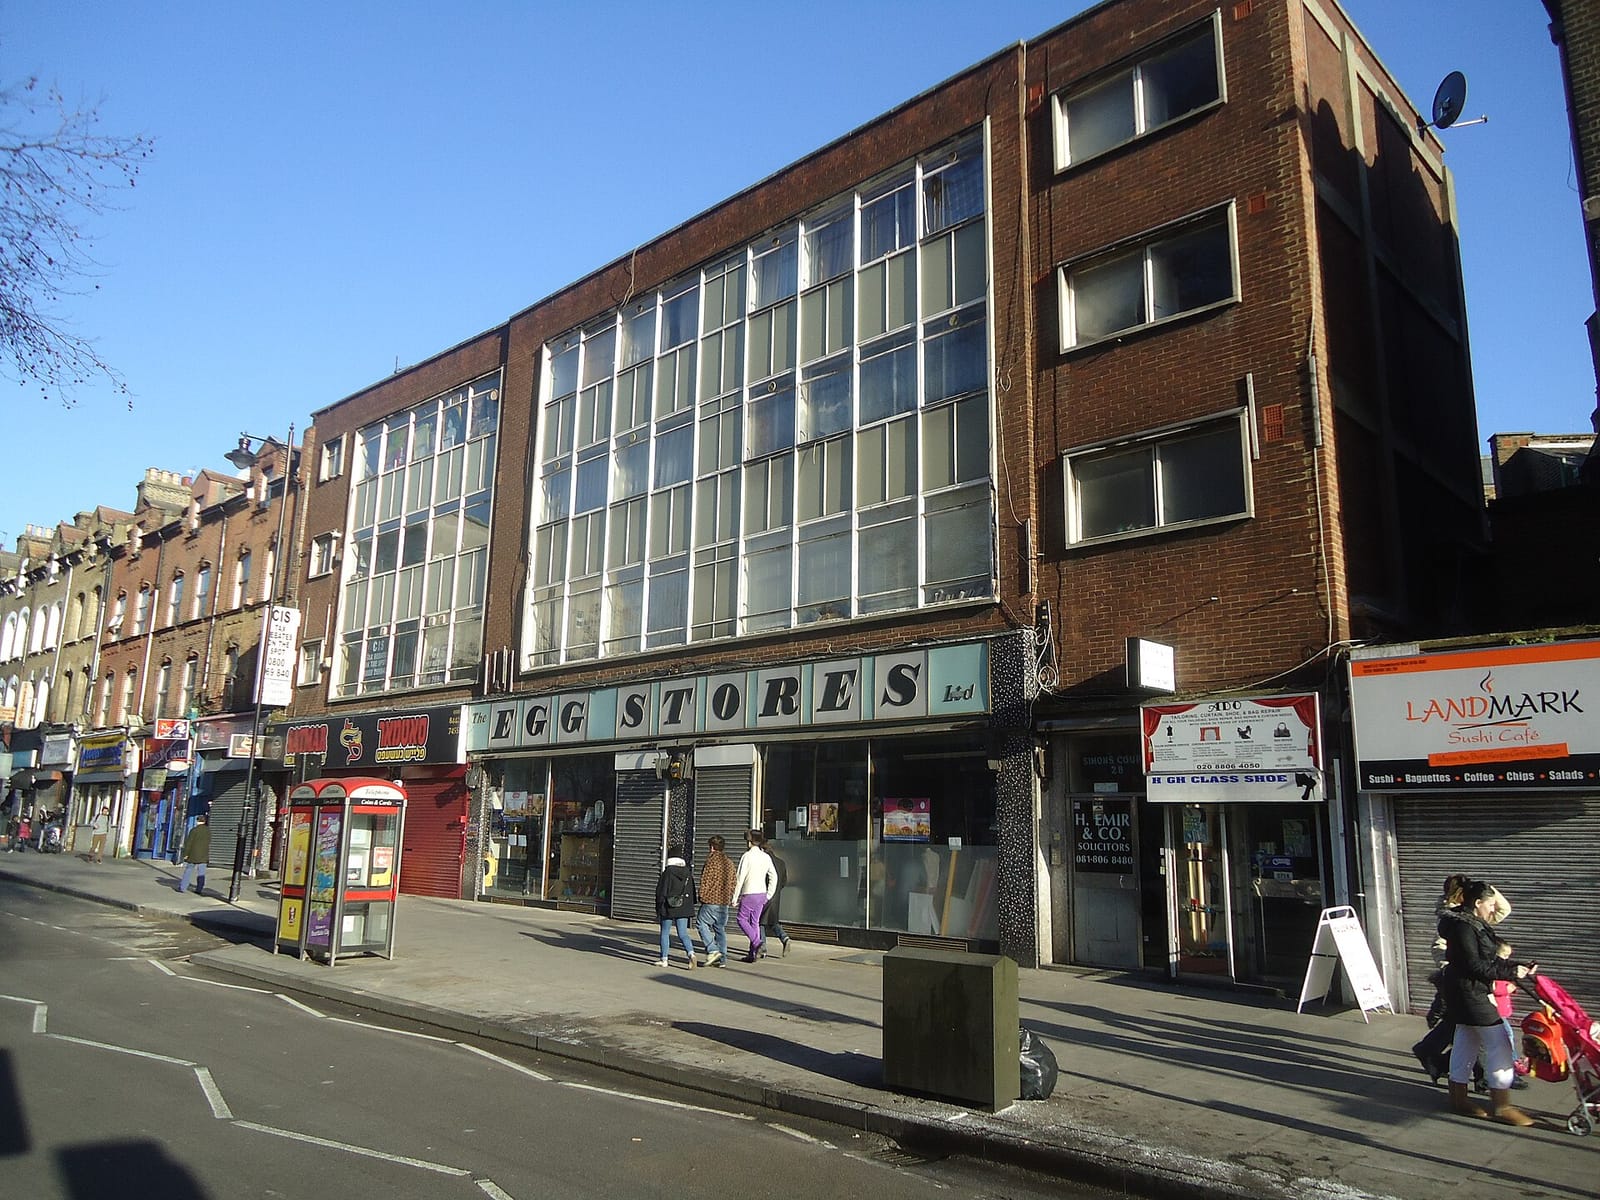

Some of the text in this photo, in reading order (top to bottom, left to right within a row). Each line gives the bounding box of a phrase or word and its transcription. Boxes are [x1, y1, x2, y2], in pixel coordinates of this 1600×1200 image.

[272, 609, 291, 623] CIS
[267, 657, 285, 667] 0800
[471, 662, 976, 740] The EGG STORES Ltd
[1207, 700, 1242, 712] ADO
[1406, 689, 1584, 723] LANDMARK
[1448, 728, 1541, 746] Sushi Café
[1191, 775, 1239, 784] CLASS
[1244, 774, 1288, 783] SHOE
[1368, 774, 1394, 784] Sushi
[1405, 772, 1451, 785] Baguettes
[1463, 772, 1495, 783] Coffee
[1506, 771, 1535, 783] Chips
[1549, 770, 1584, 781] Salads
[1075, 813, 1130, 826] H. EMIR
[1082, 827, 1126, 840] & CO.
[1078, 842, 1131, 852] SOLICITORS
[1111, 855, 1133, 865] 8480
